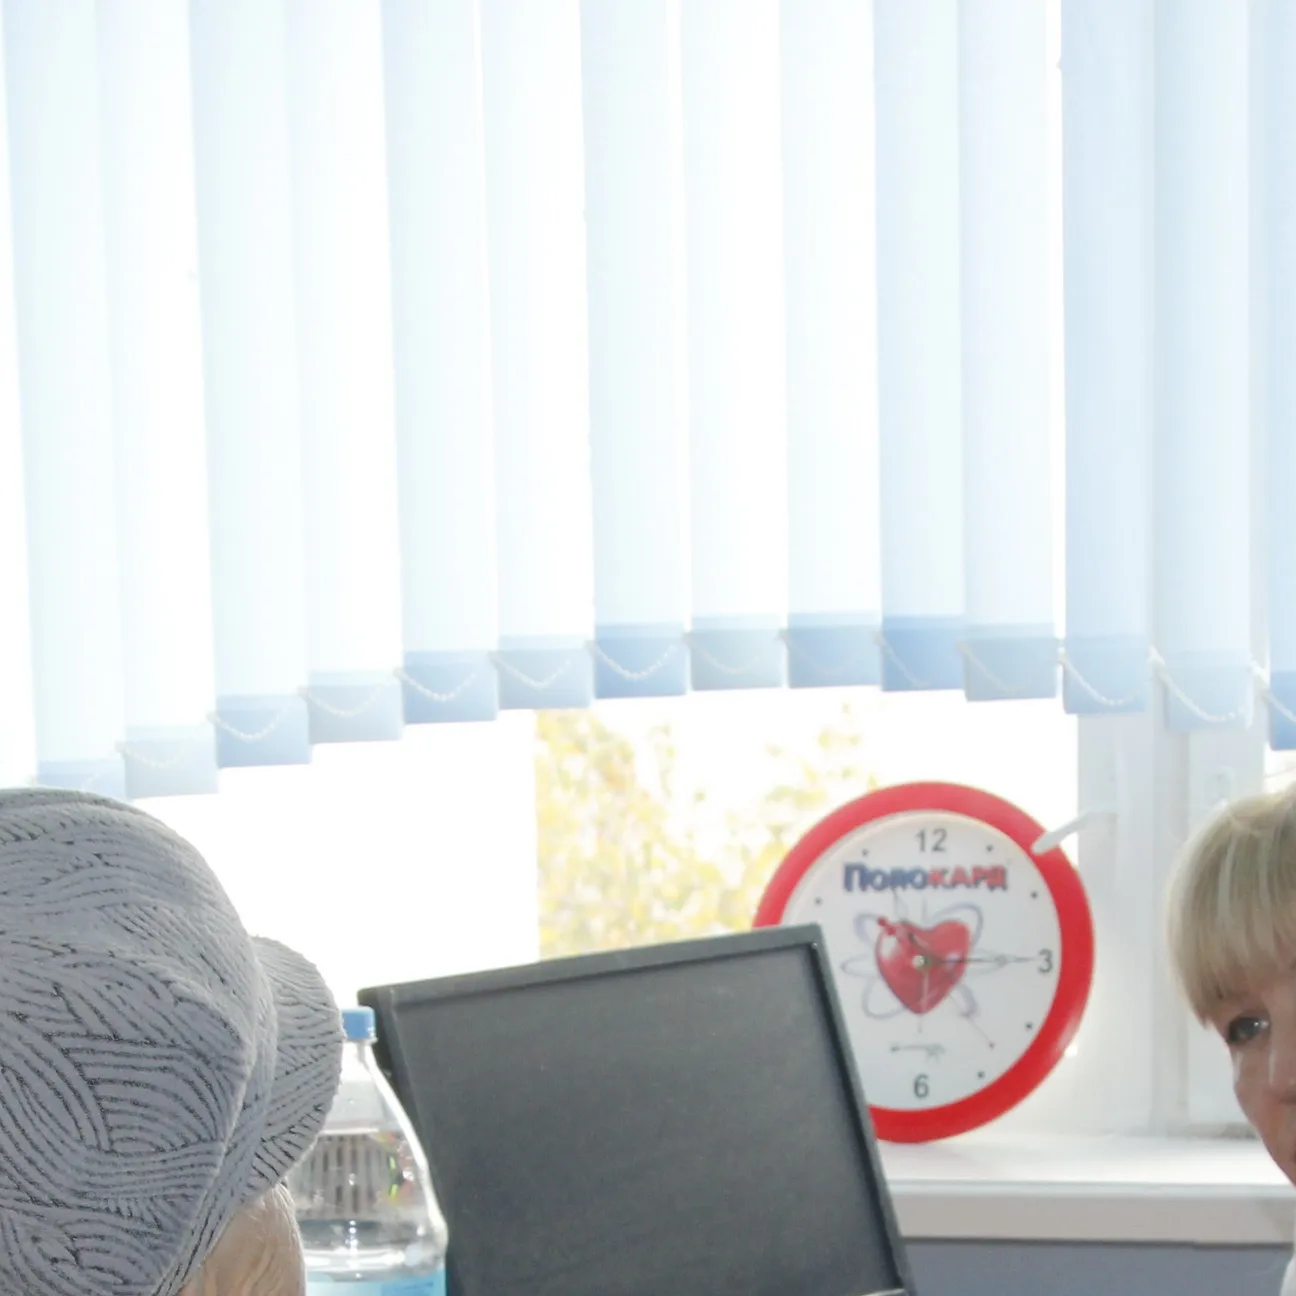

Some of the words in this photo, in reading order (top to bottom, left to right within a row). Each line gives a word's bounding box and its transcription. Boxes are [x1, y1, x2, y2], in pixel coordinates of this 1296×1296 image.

[915, 828, 948, 853] 12
[1037, 949, 1053, 974] 3
[913, 1073, 930, 1099] 6
